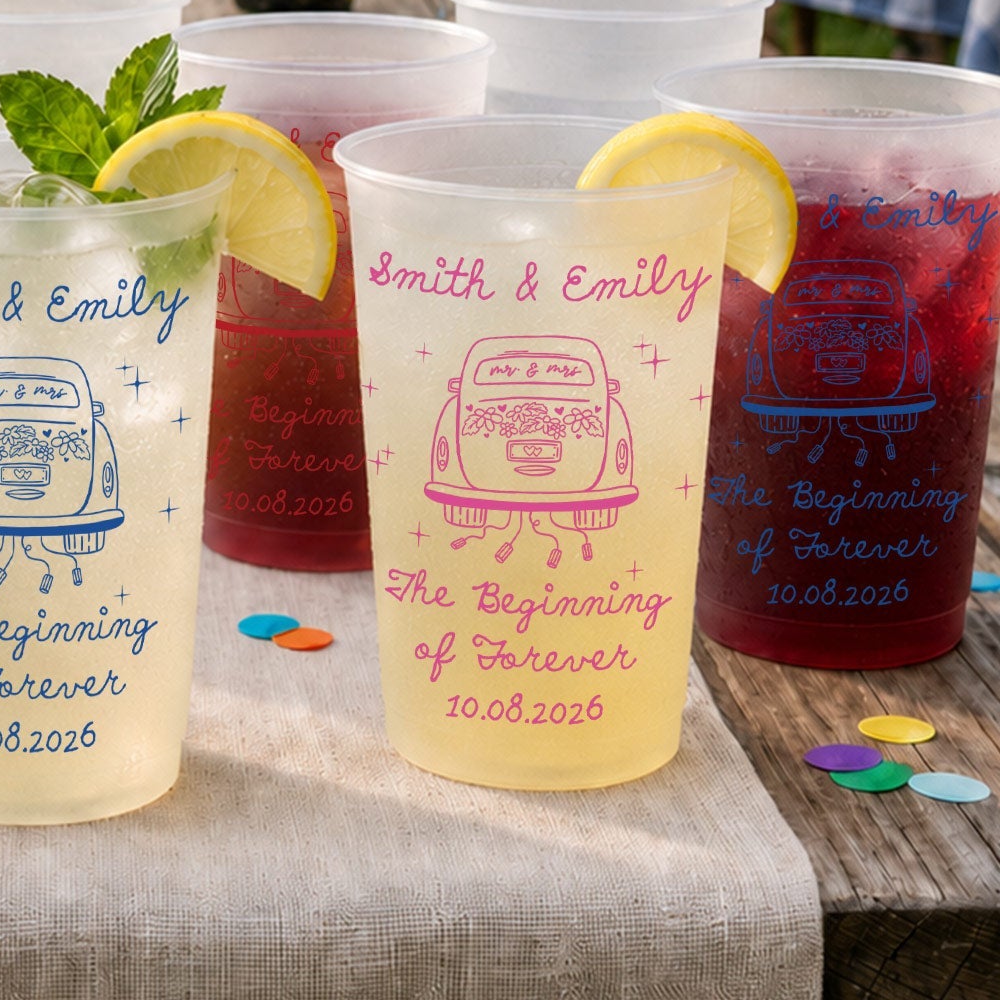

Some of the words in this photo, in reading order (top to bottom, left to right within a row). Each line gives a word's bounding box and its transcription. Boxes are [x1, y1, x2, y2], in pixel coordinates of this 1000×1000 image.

[819, 193, 840, 230] &
[861, 189, 999, 251] Emily
[2, 281, 23, 322] &
[46, 275, 190, 344] Emily
[369, 251, 495, 301] Smith
[516, 261, 538, 302] &
[562, 254, 713, 323] Emily
[15, 383, 26, 398] &
[34, 384, 68, 399] mrs
[526, 361, 538, 377] &
[546, 363, 582, 378] mrs
[245, 440, 366, 472] Foreve
[224, 489, 353, 516] 10.08.2026
[708, 473, 773, 506] The
[787, 479, 968, 526] Beginning
[737, 527, 775, 574] of
[789, 528, 938, 560] Forever
[385, 569, 455, 608] The
[472, 580, 673, 633] Beginning
[767, 578, 909, 606] 10.08.2026
[415, 632, 456, 682] of
[472, 634, 638, 673] Forever
[445, 694, 604, 725] 10.08.2026
